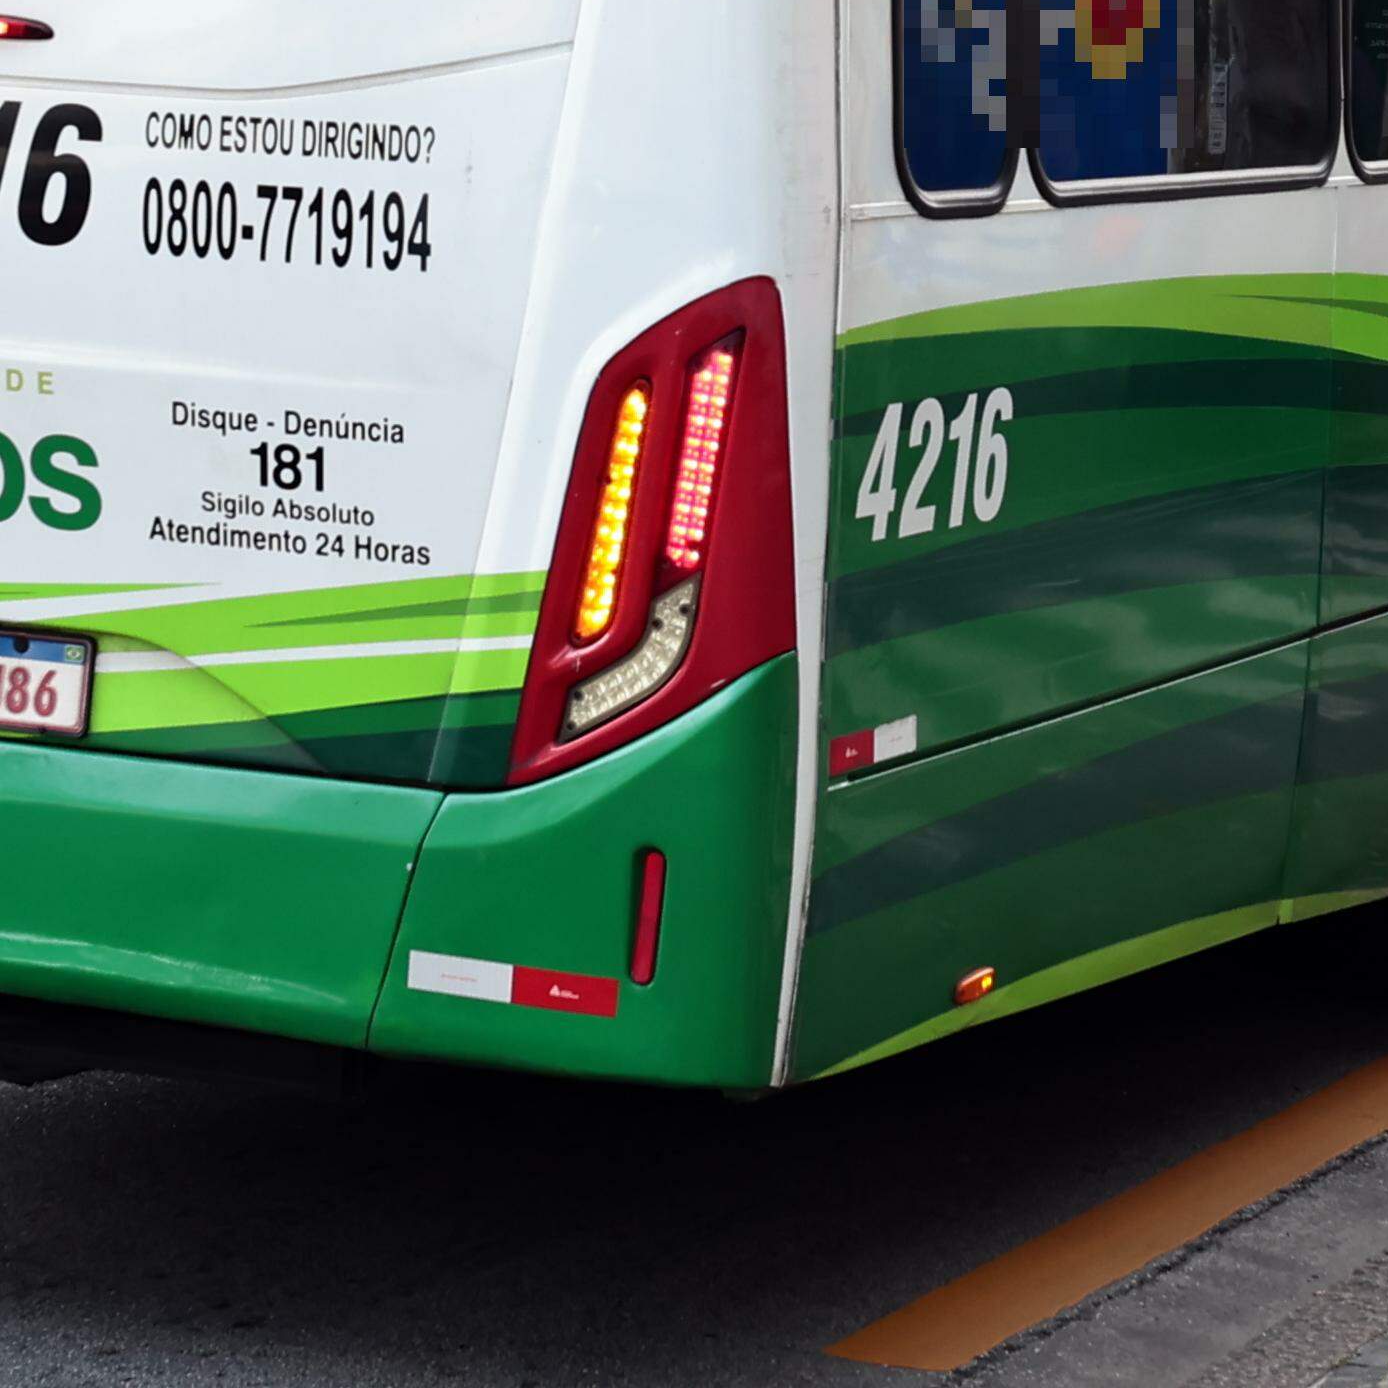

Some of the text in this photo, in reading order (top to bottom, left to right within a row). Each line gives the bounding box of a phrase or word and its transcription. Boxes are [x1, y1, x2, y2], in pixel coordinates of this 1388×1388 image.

[145, 111, 436, 164] COMO ESTOU DIRIGINDO?
[143, 176, 432, 272] 0800-7719194
[5, 368, 55, 395] DE
[171, 400, 258, 437] Disque
[284, 409, 405, 444] Denúncia
[250, 441, 325, 492] 181
[855, 386, 1014, 542] 4216
[201, 490, 375, 527] Sigilo Absoluto
[149, 515, 431, 566] Atendimento 24 Horas
[0, 663, 57, 718] 86
